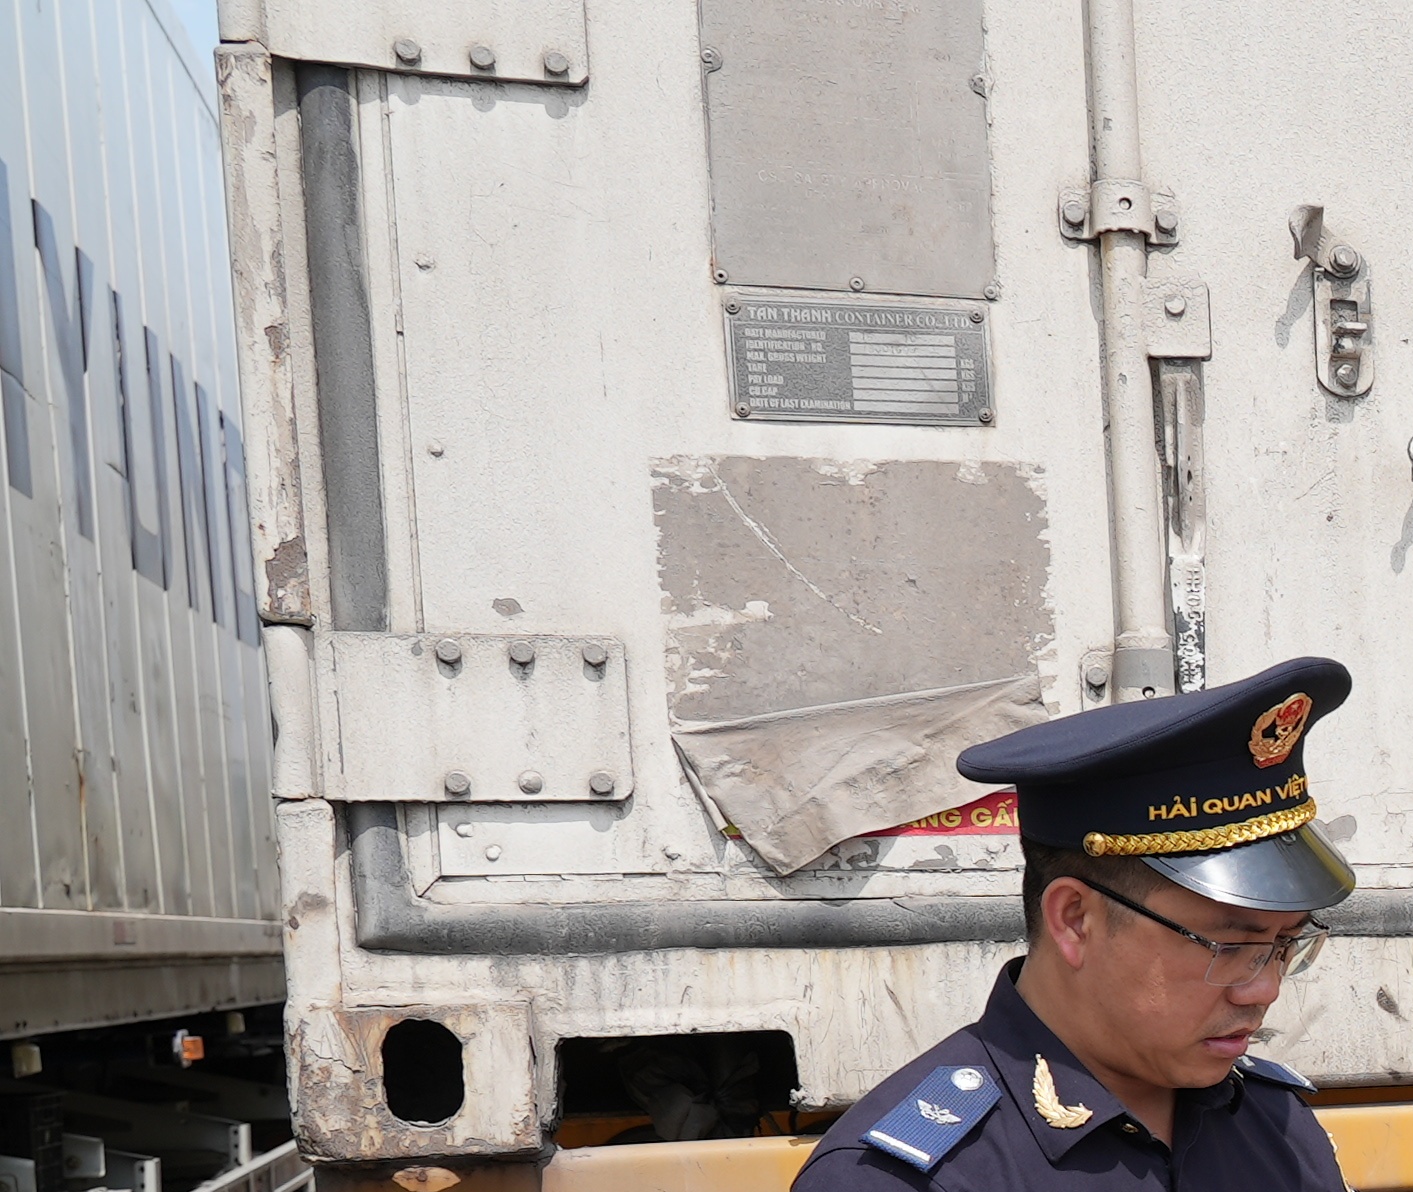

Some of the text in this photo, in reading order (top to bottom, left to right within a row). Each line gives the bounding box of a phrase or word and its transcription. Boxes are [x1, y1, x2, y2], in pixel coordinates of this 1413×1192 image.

[747, 306, 778, 320] TAN
[781, 307, 832, 323] THANH
[835, 309, 914, 327] CONTAINER
[1203, 788, 1272, 815] QUAN
